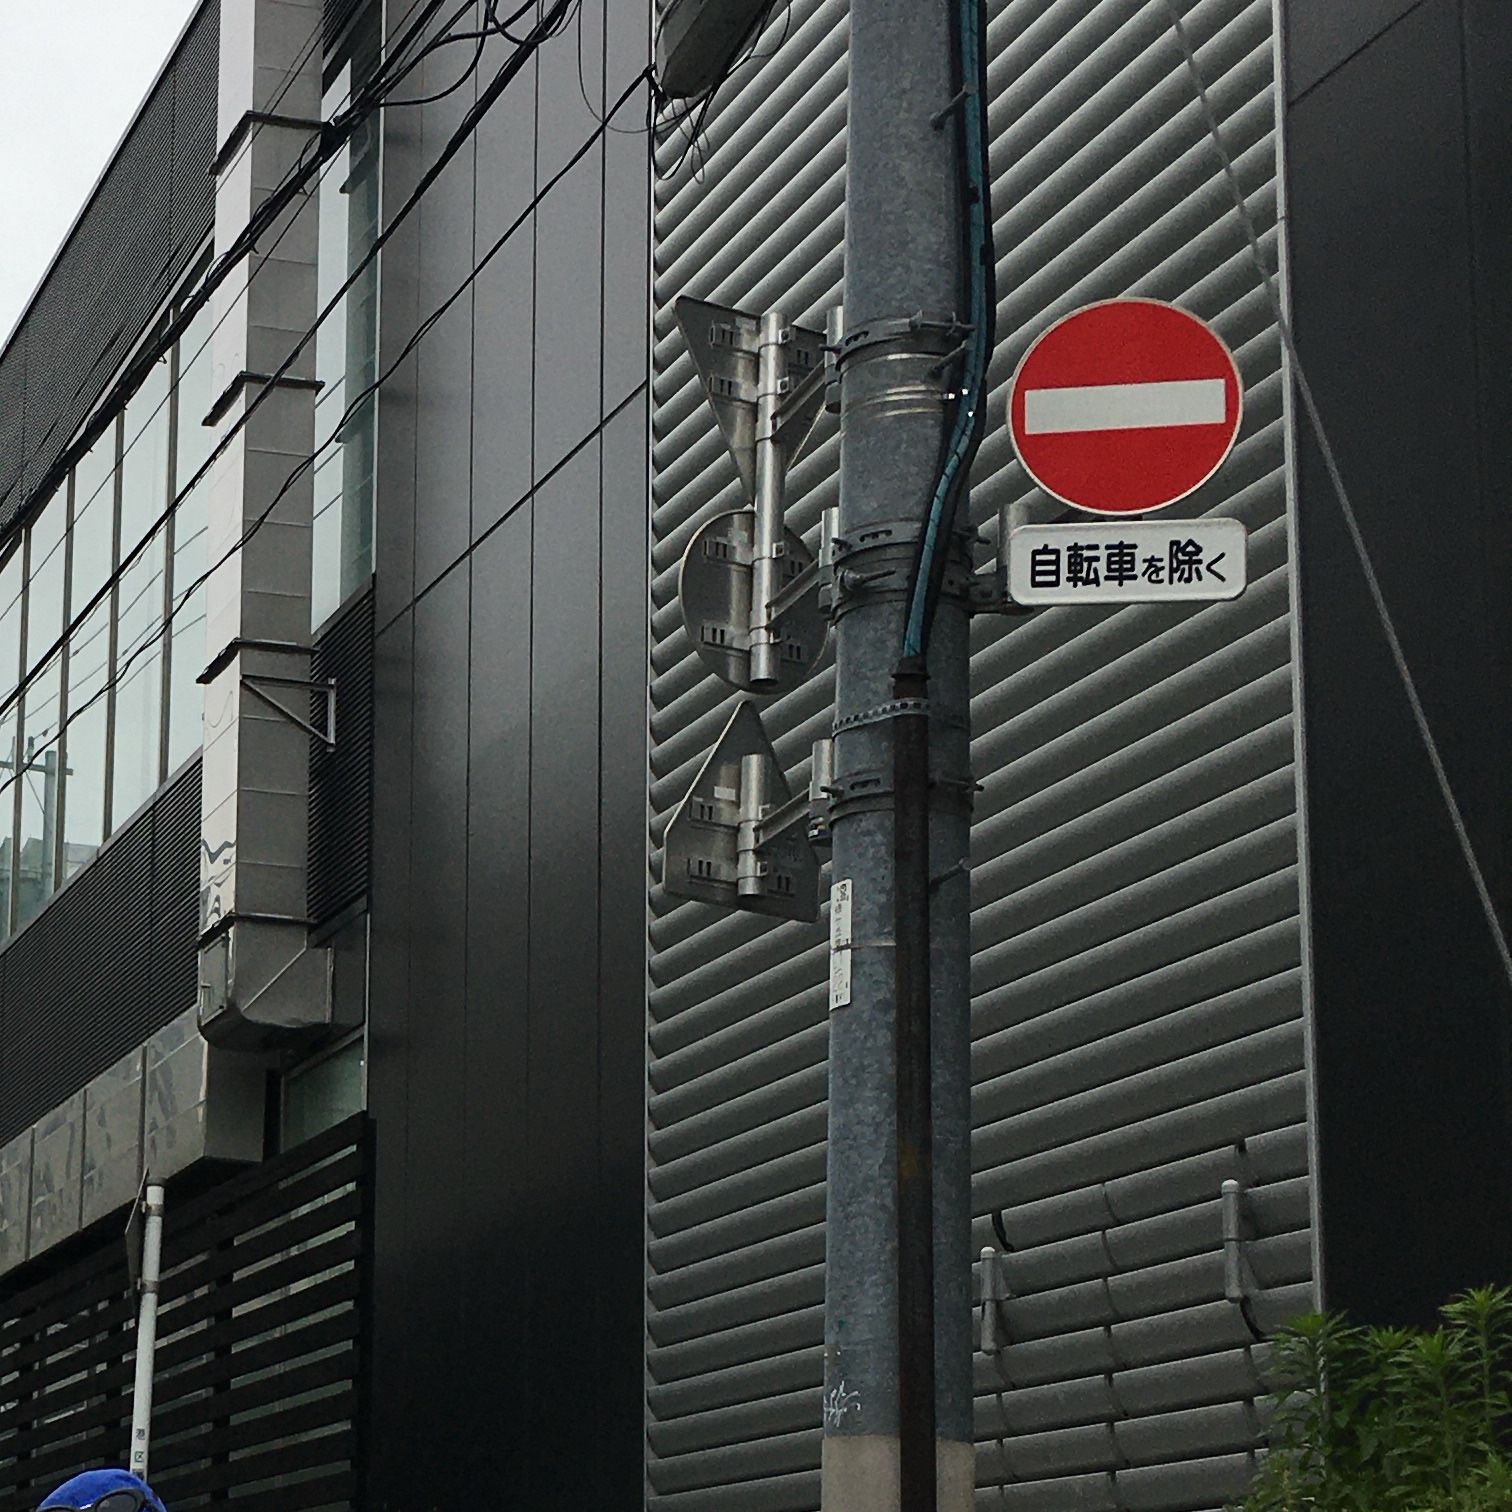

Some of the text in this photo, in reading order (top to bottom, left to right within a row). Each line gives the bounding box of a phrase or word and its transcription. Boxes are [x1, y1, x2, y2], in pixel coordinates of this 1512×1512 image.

[1029, 538, 1227, 590] 自転車を除く
